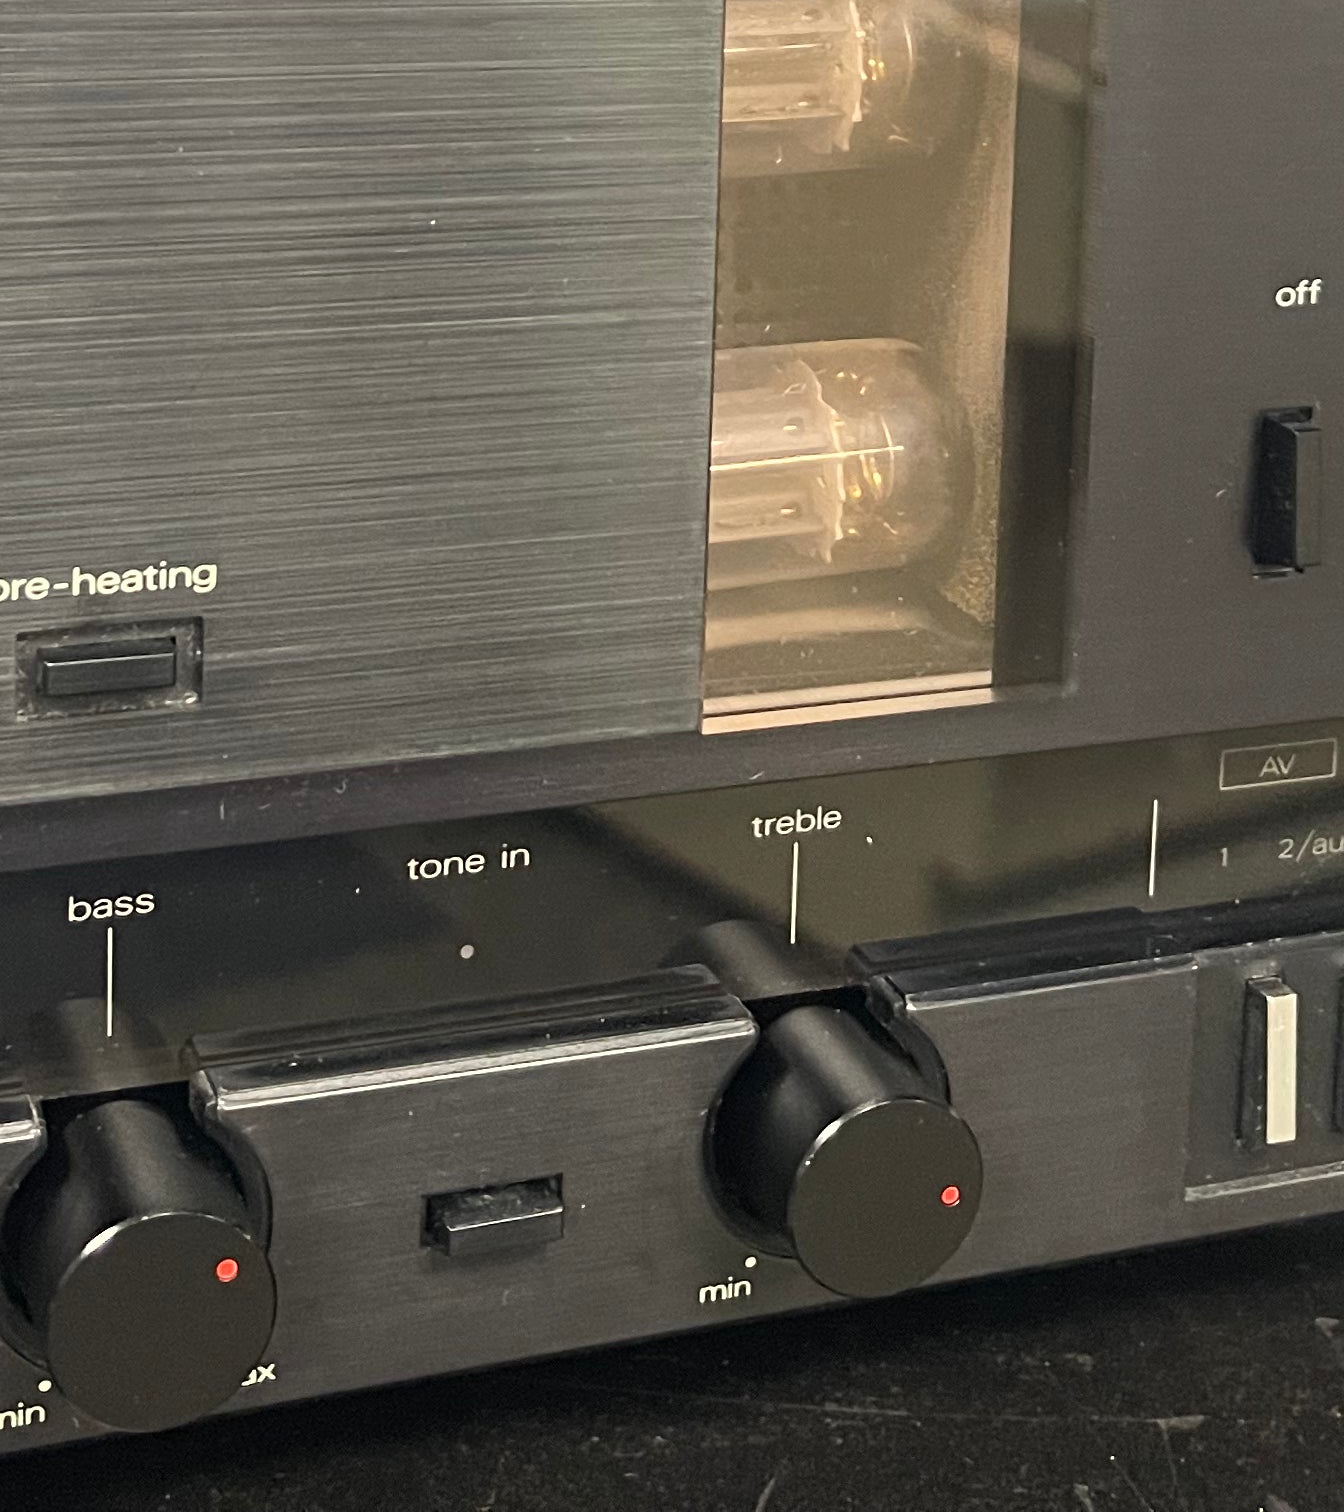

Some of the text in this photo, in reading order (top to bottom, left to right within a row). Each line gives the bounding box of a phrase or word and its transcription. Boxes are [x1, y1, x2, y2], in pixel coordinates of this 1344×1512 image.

[1274, 278, 1322, 307] off
[1259, 755, 1297, 777] AV
[752, 806, 843, 838] treble
[406, 844, 532, 881] tone in
[1221, 847, 1229, 867] 1
[67, 890, 156, 923] bass
[698, 1273, 753, 1305] min
